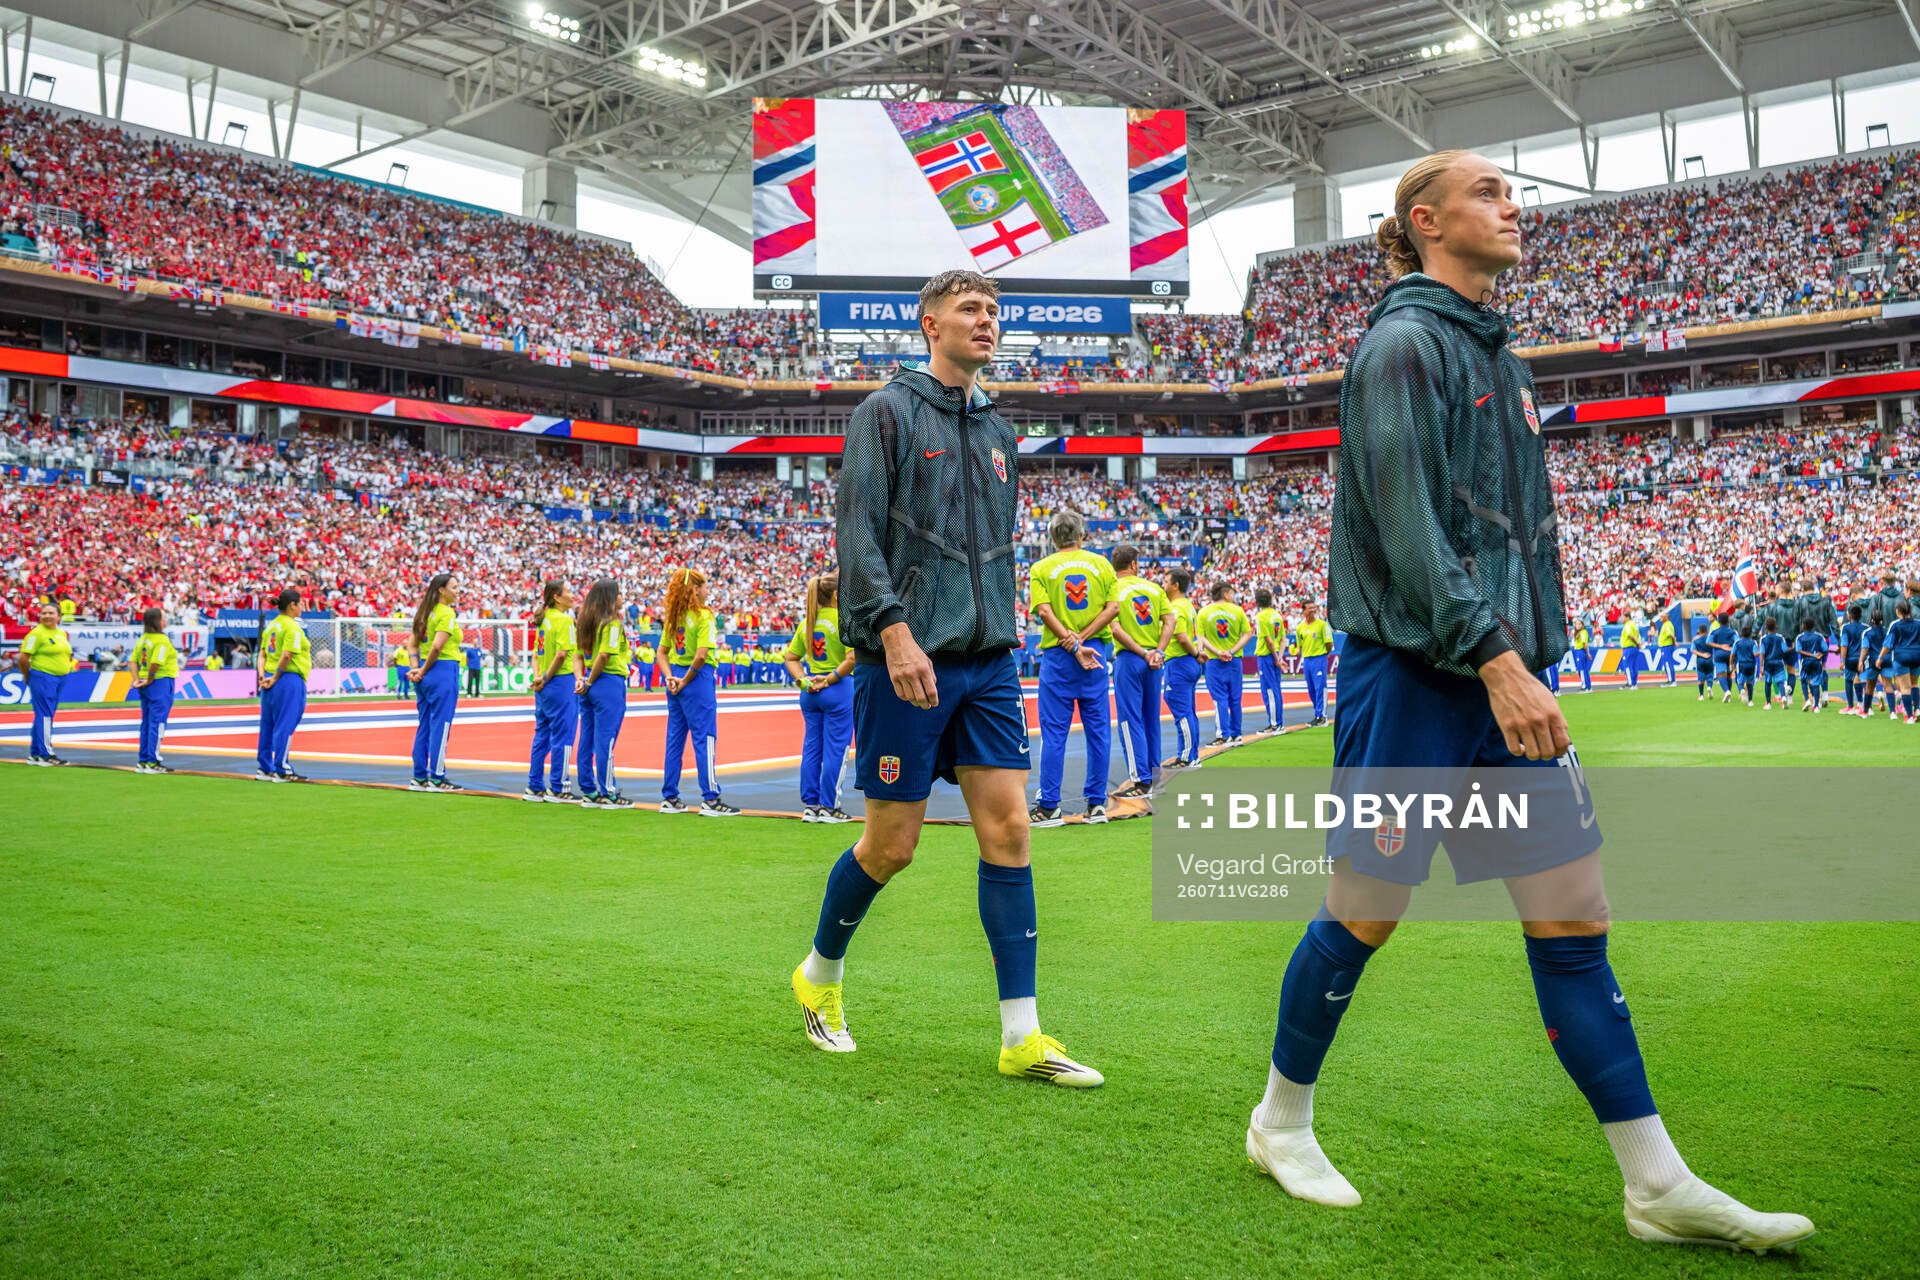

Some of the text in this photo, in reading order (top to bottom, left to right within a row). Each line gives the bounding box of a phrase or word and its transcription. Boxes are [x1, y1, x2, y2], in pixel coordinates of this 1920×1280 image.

[774, 277, 791, 287] CC
[1153, 283, 1169, 294] CC
[850, 303, 897, 320] FIFA
[998, 305, 1025, 322] UP
[1028, 305, 1103, 323] 2026
[228, 619, 259, 628] WORLD
